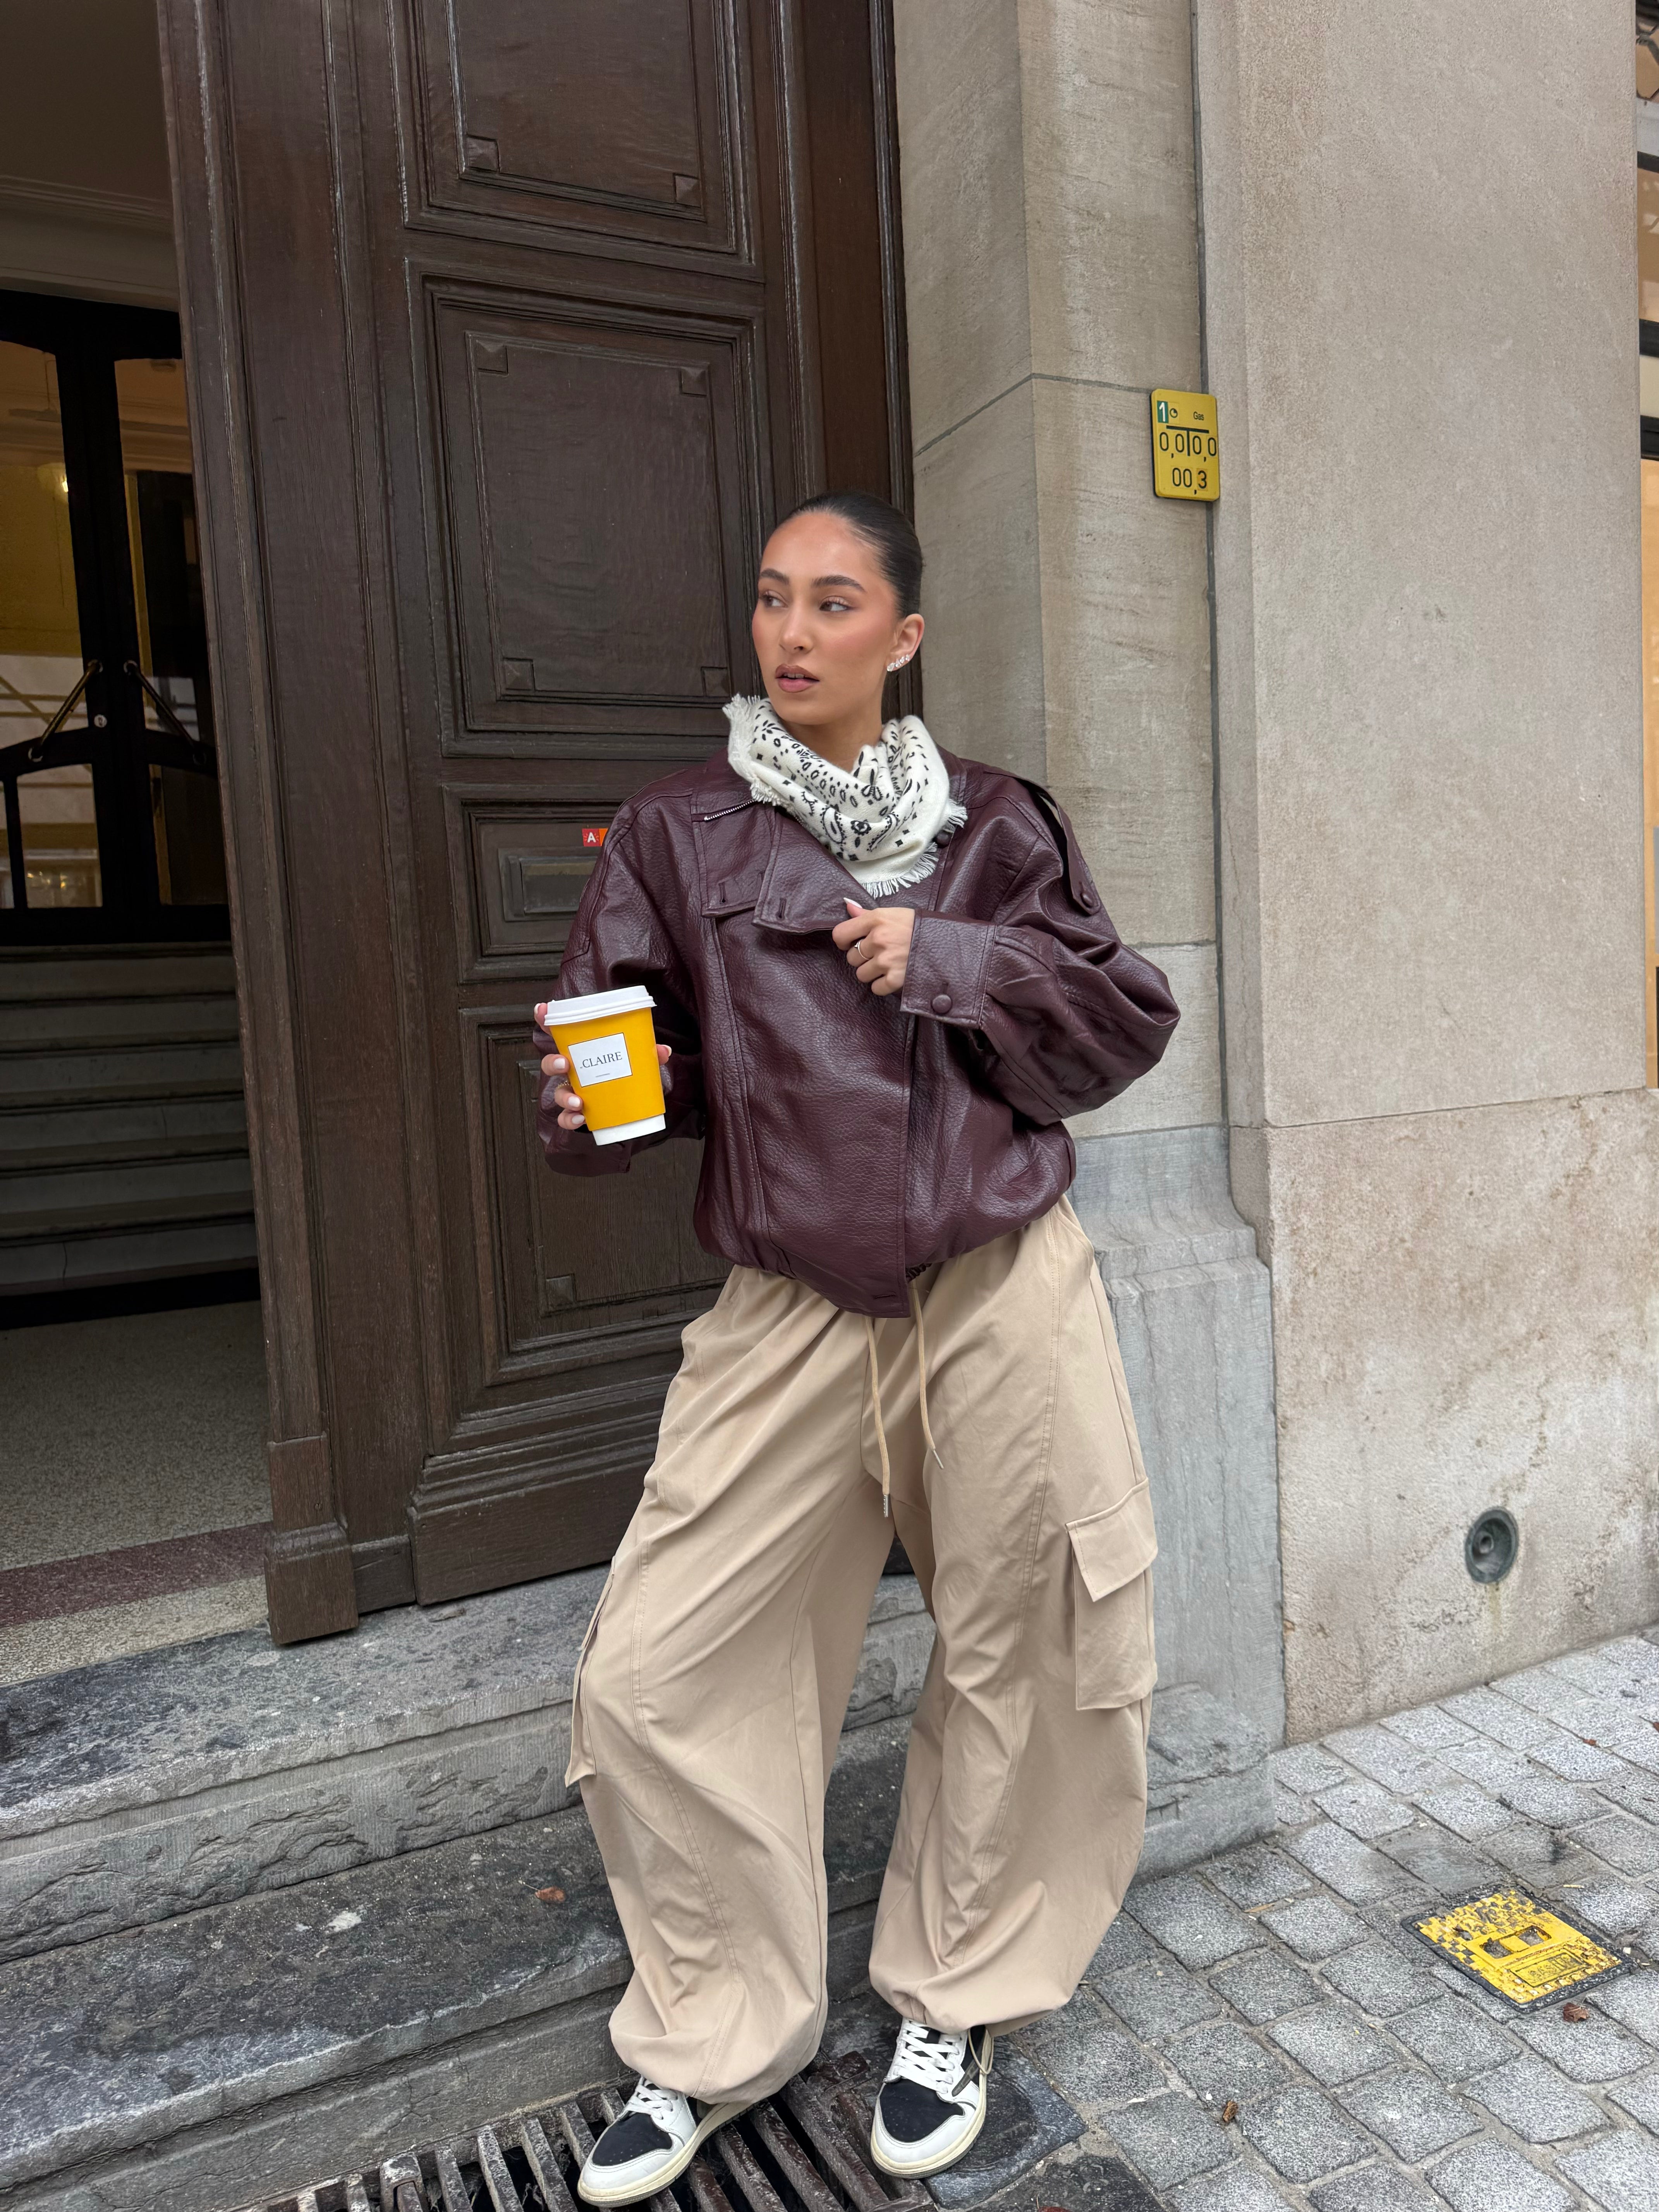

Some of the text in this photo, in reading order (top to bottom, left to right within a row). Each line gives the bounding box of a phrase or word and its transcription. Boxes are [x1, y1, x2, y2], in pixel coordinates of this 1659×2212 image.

[1193, 411, 1205, 421] Gas
[587, 832, 596, 843] A
[582, 1051, 622, 1068] CLAIRE
